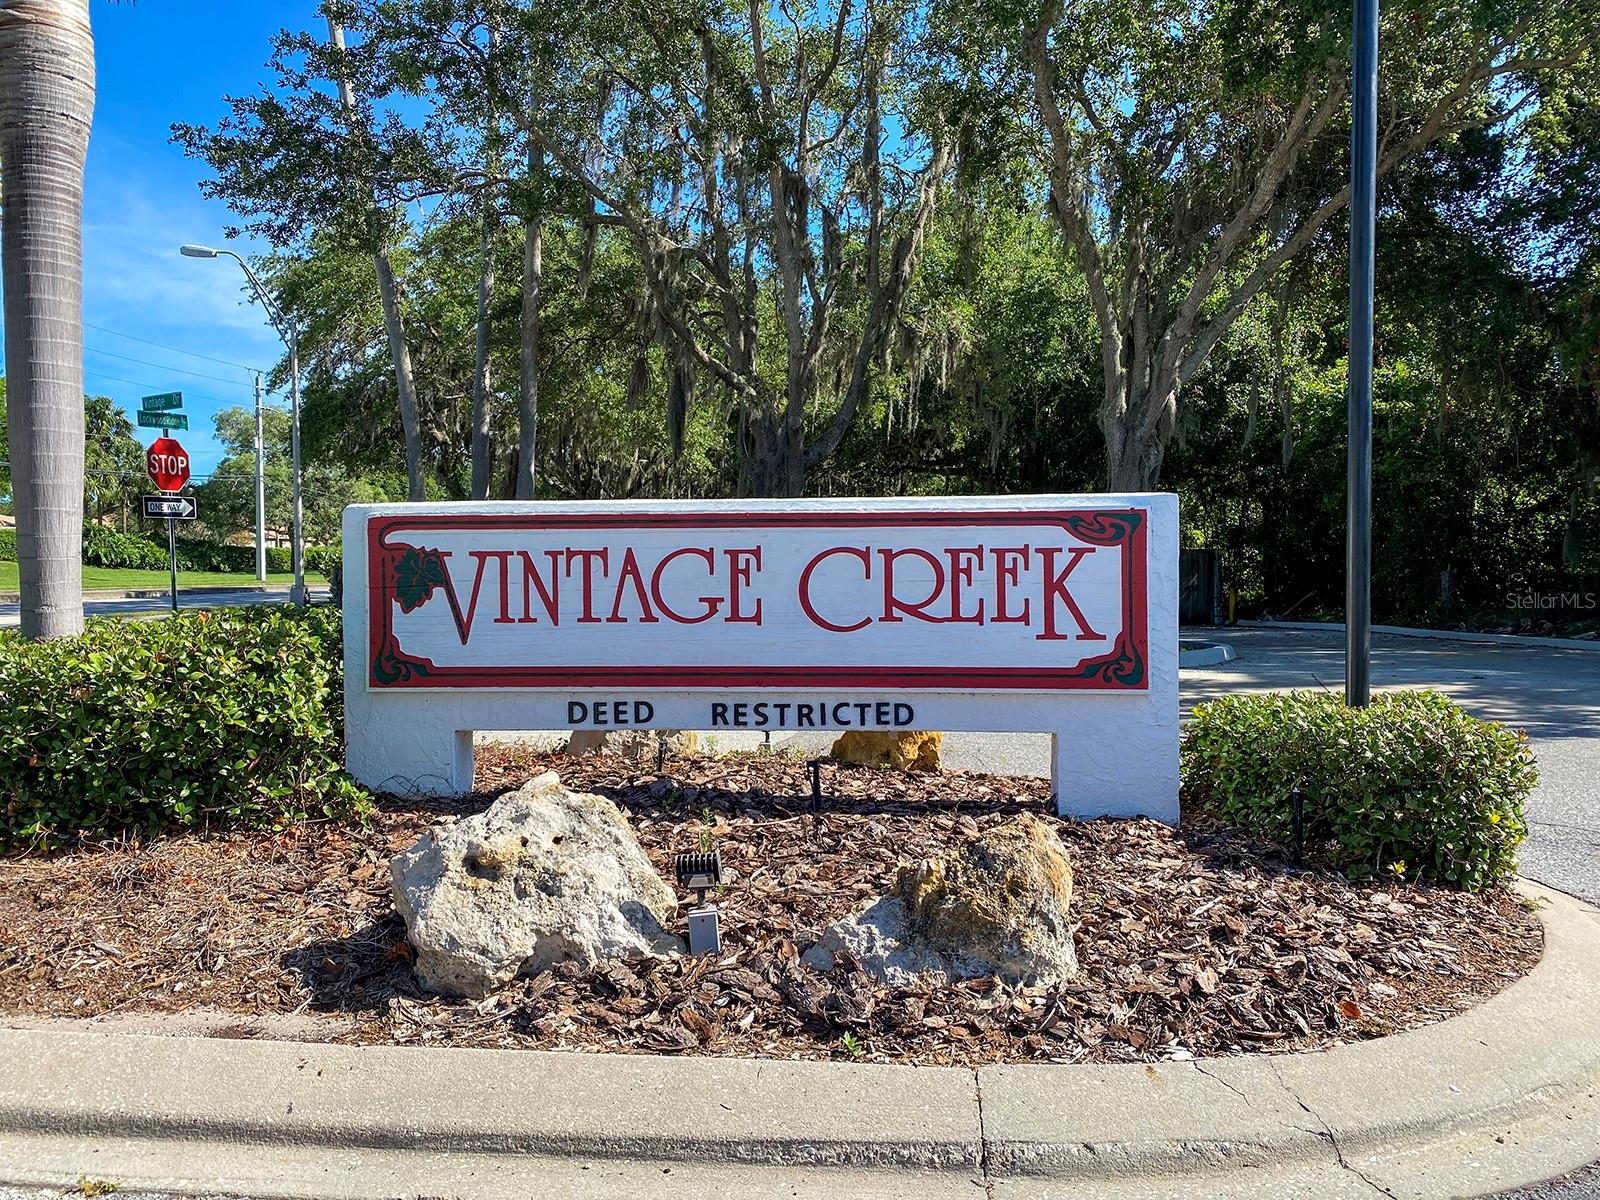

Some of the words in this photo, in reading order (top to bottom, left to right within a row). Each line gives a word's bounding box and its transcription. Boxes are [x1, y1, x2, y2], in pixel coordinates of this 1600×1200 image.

[144, 397, 166, 409] Vintage
[172, 394, 180, 405] Dr
[150, 454, 187, 475] STOP
[149, 502, 165, 512] ONE
[166, 502, 182, 512] WAY
[439, 545, 762, 645] VINTAGE
[798, 544, 1107, 641] CREEK
[568, 702, 654, 725] DEED
[711, 703, 915, 727] RESTRICTED
